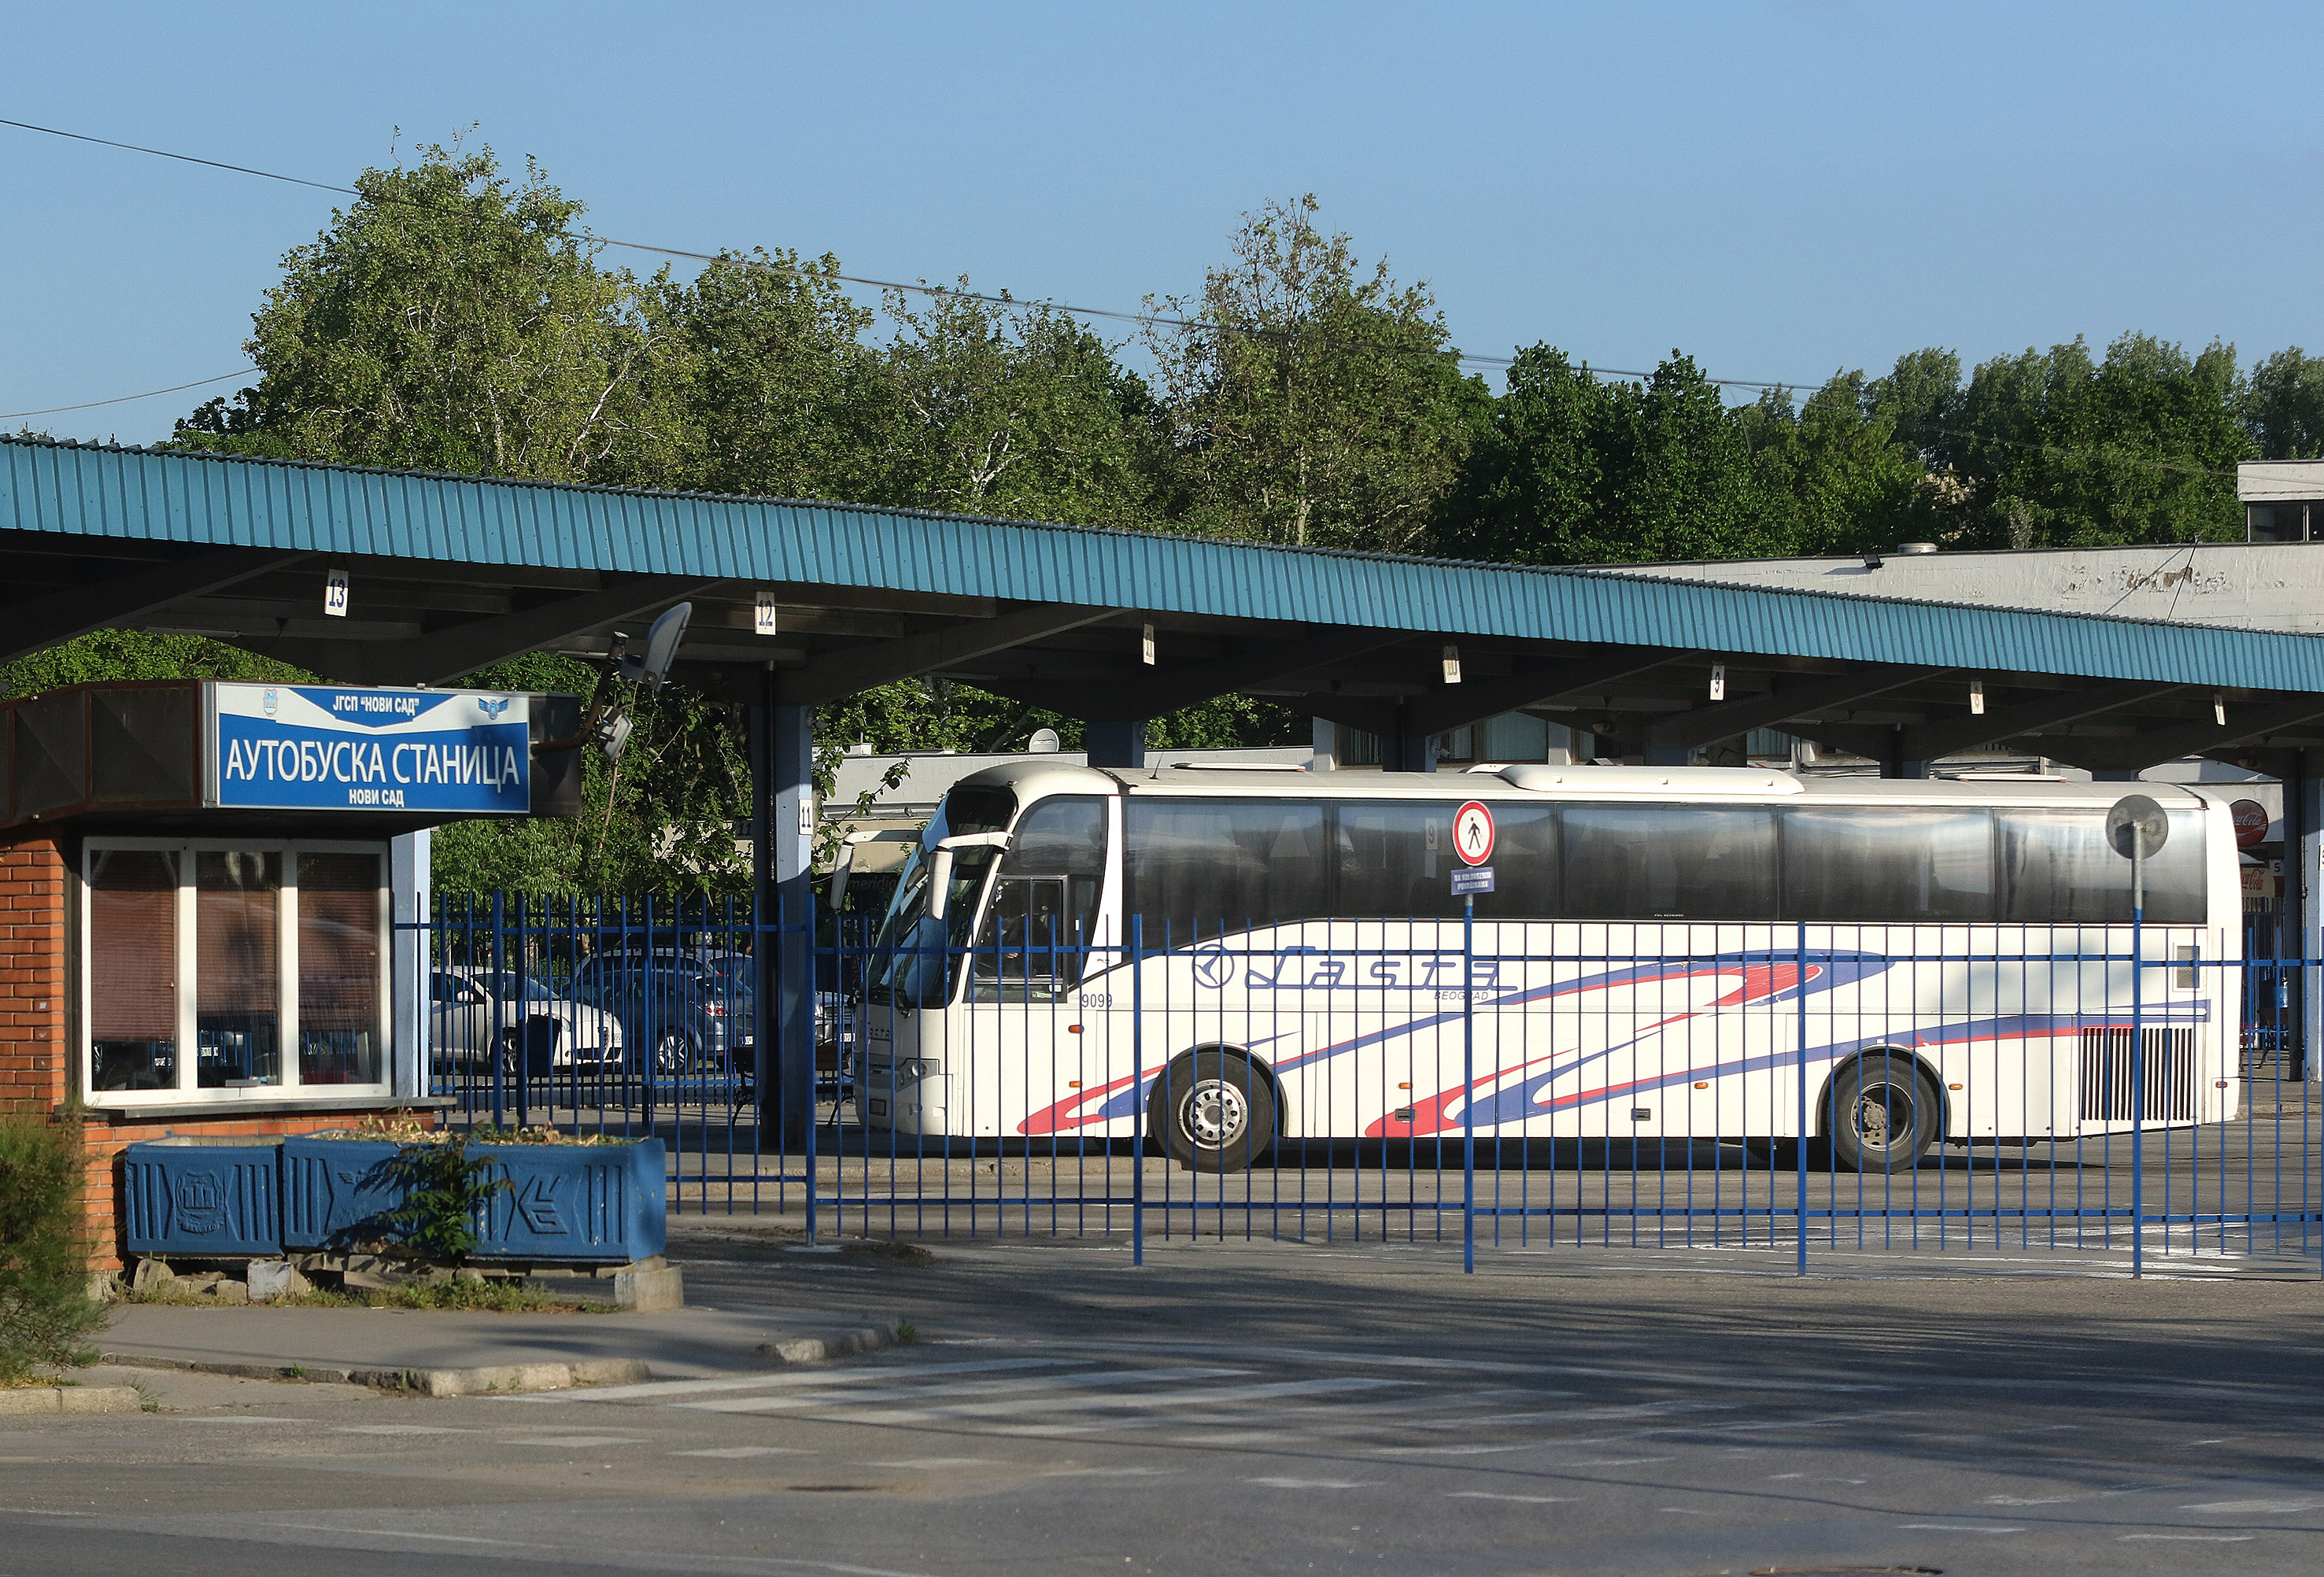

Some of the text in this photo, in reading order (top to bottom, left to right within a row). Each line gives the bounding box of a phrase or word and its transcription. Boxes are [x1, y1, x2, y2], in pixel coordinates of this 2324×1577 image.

[329, 578, 345, 608] 13
[759, 600, 773, 626] 12
[1715, 671, 1720, 693] 9
[332, 696, 359, 712] ЈГСП
[226, 738, 520, 793] АУТОБУСКА СТАНИЦА
[349, 789, 405, 807] НОВИ САД
[801, 806, 811, 828] 11
[2274, 862, 2281, 873] 5
[1081, 993, 1113, 1008] 9099
[1434, 991, 1489, 1000] BEOGAD
